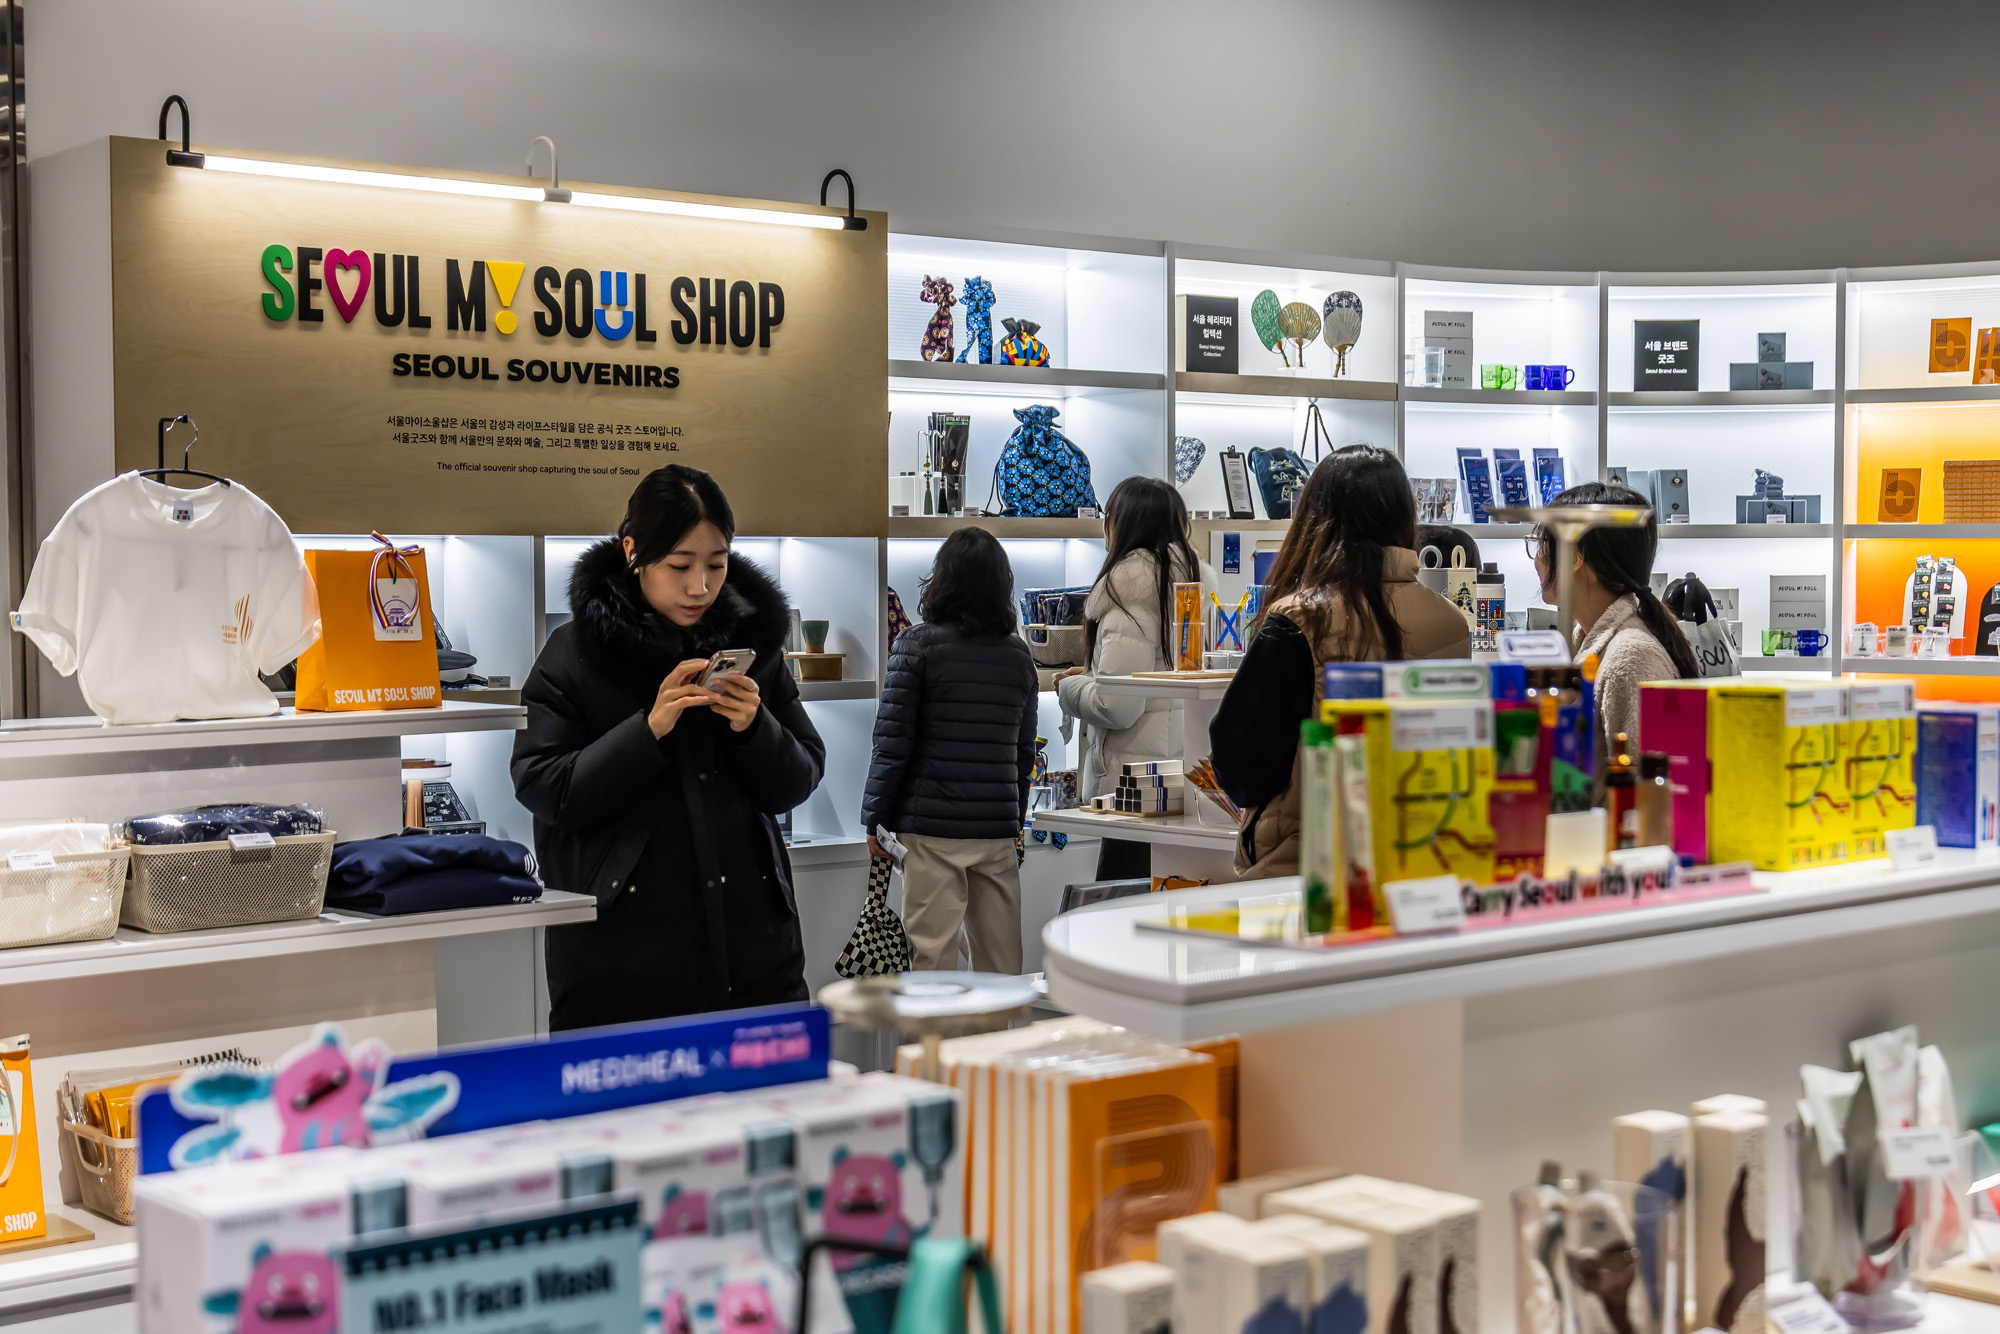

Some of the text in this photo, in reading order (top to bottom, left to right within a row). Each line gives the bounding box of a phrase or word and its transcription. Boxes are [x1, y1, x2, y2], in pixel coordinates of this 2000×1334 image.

[534, 265, 656, 341] SOUL
[670, 276, 785, 348] SHOP
[1192, 314, 1232, 326] 서울 헤리티지
[1203, 328, 1222, 339] 컬렉션
[1645, 341, 1688, 351] 서울 브랜드
[1658, 354, 1675, 364] 굿즈
[393, 353, 680, 388] SEOUL SOUVENIRS
[386, 415, 684, 437] 서울마이소울샵은 서울의 감성과 라이프스타일을 담은 공식 굿즈 스토어입니다.
[392, 432, 680, 452] 서울굿즈와 함께 서울만의 문화와 예술, 그리고 특별한 일상을 경험해 보세요.
[437, 462, 640, 476] The official souvenir shop capturing the soul of Seoul
[384, 687, 409, 702] SOUL
[410, 686, 436, 700] SHOP
[1461, 884, 1516, 917] Carry
[1519, 867, 1577, 907] Seoul
[1580, 863, 1627, 898] with
[562, 1047, 707, 1096] MEDIHEAL
[4, 1211, 38, 1233] SHOP
[455, 1280, 527, 1323] Face
[534, 1257, 617, 1302] Mask
